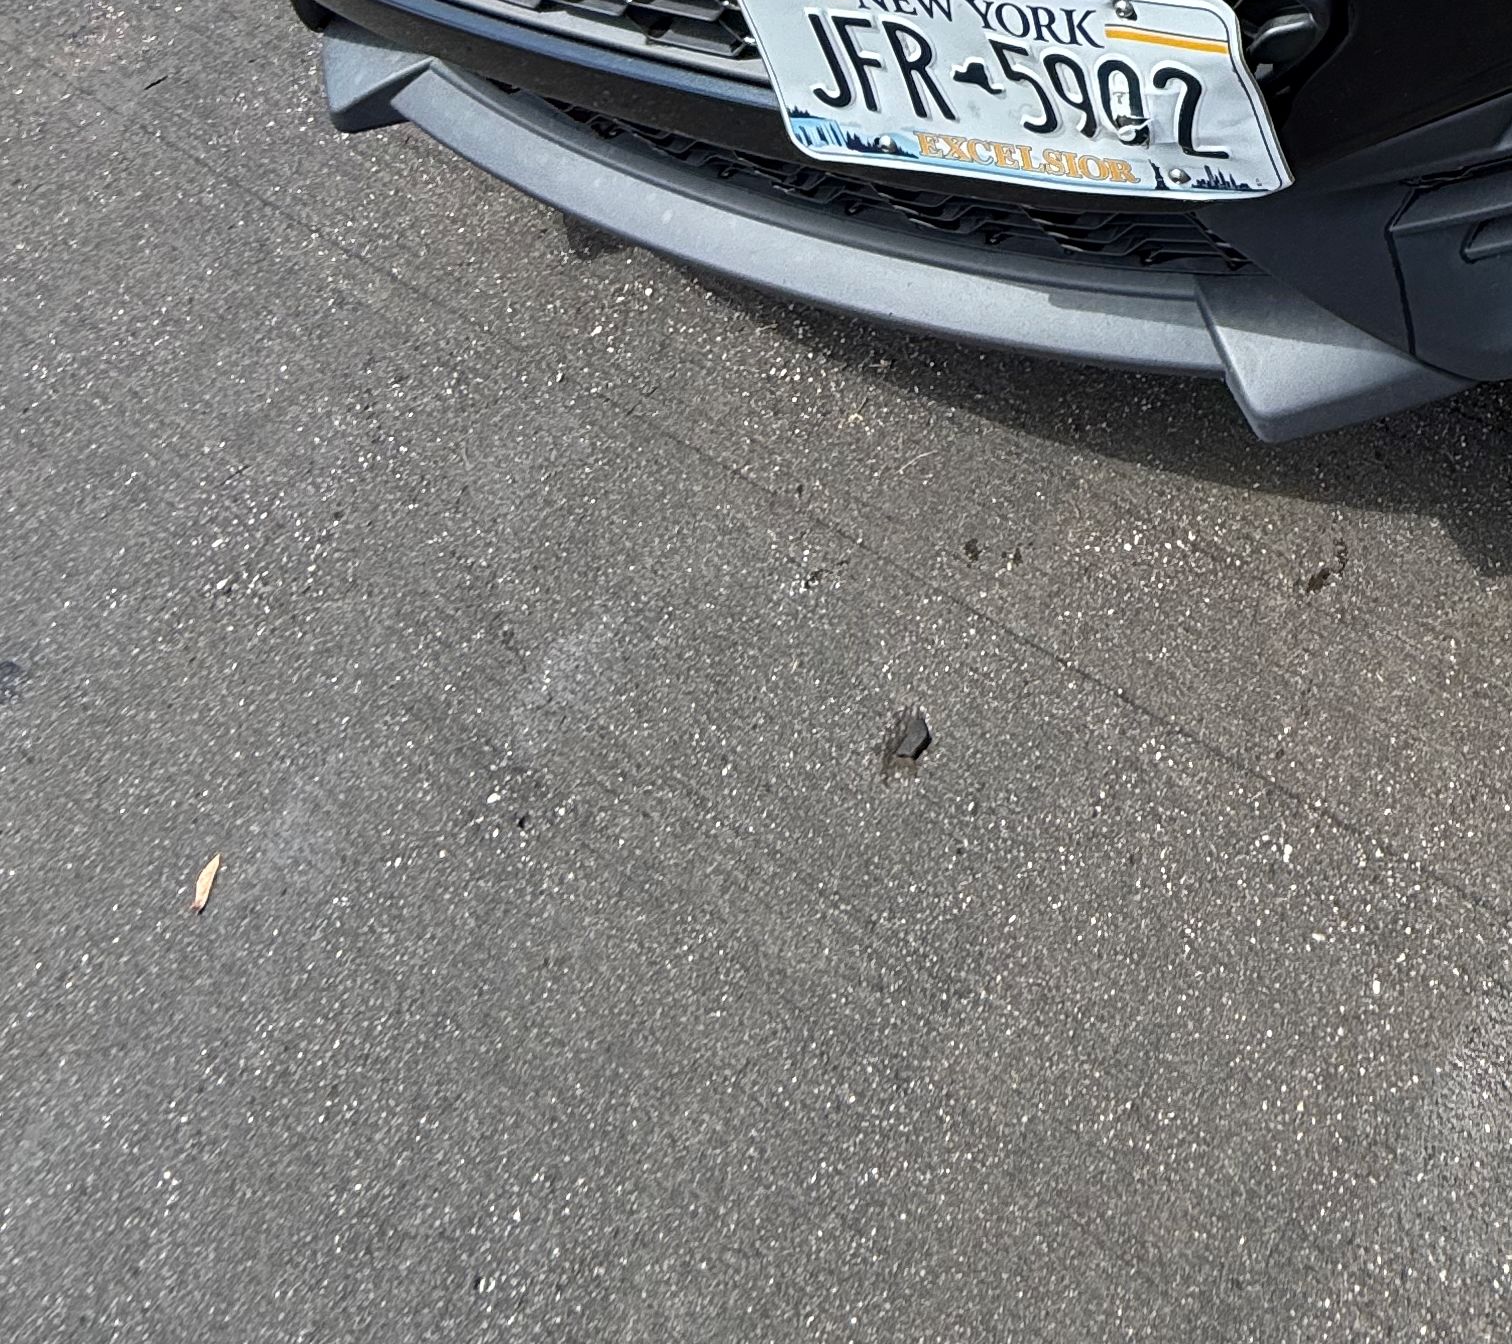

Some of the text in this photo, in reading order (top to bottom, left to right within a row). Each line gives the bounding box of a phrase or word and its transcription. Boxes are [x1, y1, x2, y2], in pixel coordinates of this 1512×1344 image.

[804, 12, 1230, 161] JFR 5902
[912, 129, 1141, 185] EXCELSIOR
